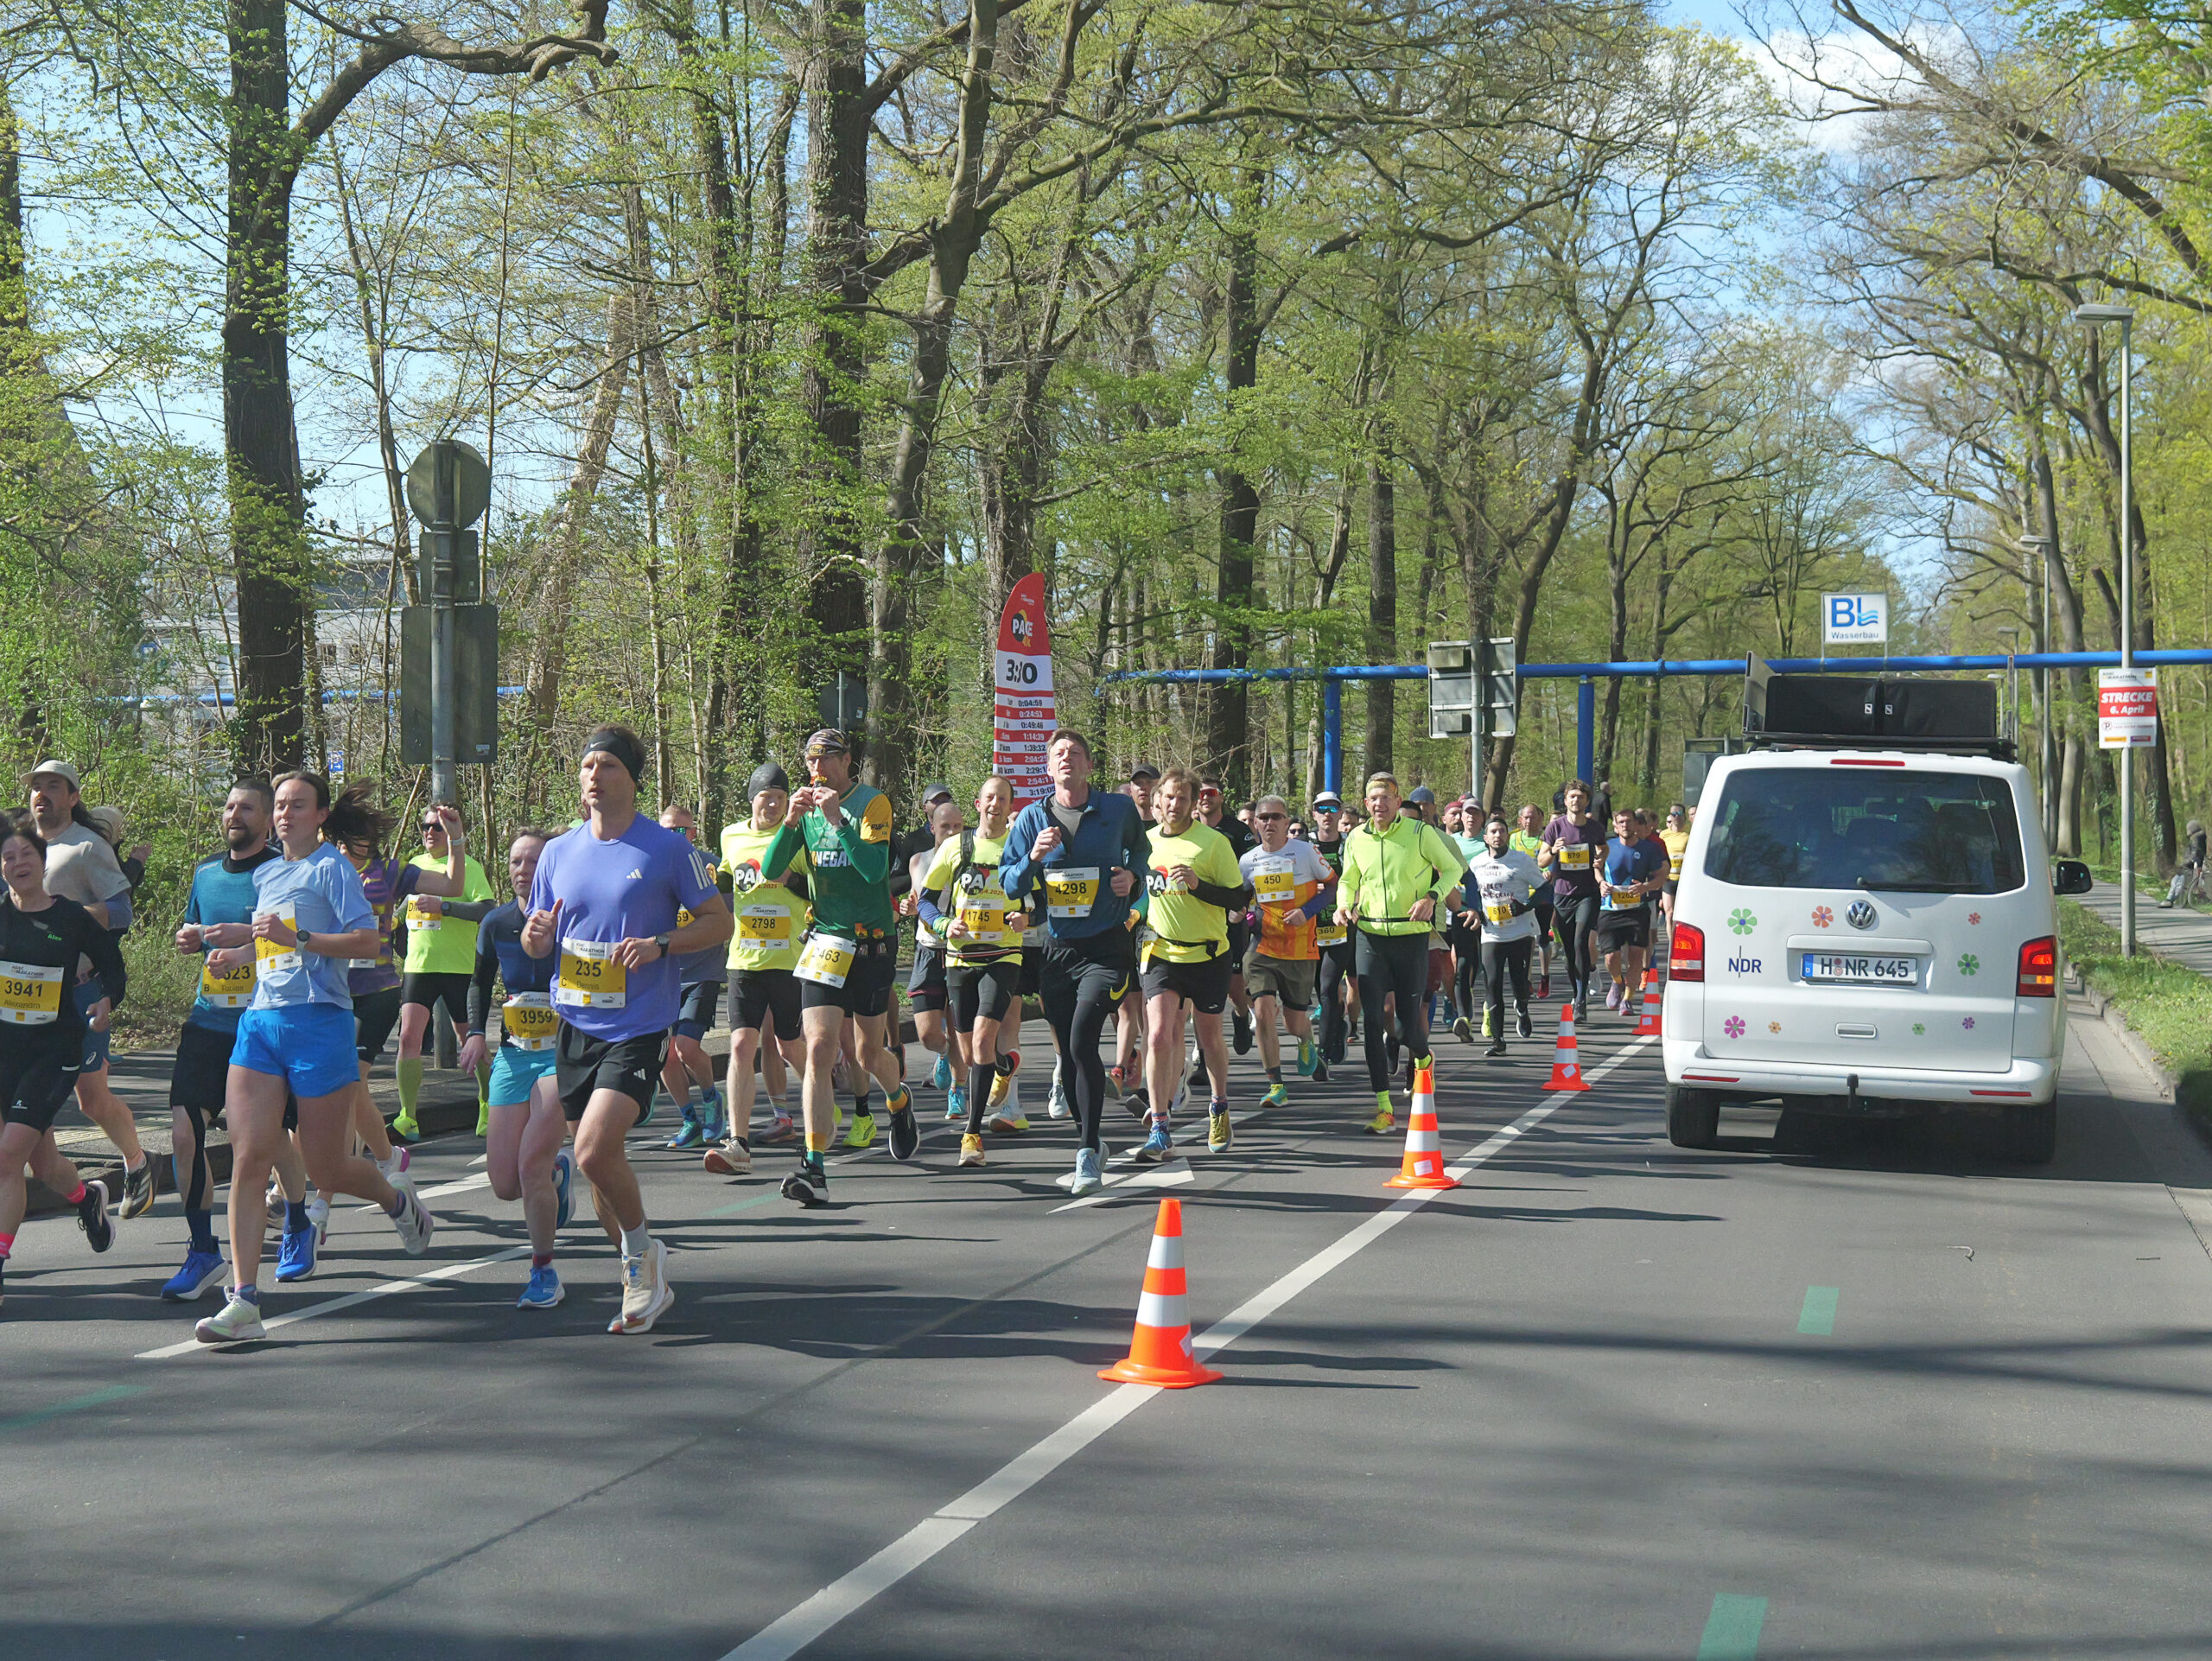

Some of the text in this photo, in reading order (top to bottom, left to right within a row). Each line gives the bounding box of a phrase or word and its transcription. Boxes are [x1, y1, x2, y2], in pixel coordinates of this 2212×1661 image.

[1012, 619, 1033, 636] PACE
[2101, 691, 2153, 703] STRECKE
[2120, 705, 2145, 716] April
[1264, 875, 1281, 884] 450
[1055, 882, 1087, 894] 4298
[752, 918, 775, 928] 2798
[968, 912, 989, 922] 1745
[575, 960, 601, 977] 235
[1728, 958, 1762, 973] NDR
[1821, 958, 1909, 978] H NR 645
[4, 980, 43, 997] 3941
[576, 981, 600, 990] Dennis
[3, 999, 41, 1009] Alexandra
[520, 1009, 552, 1024] 3959
